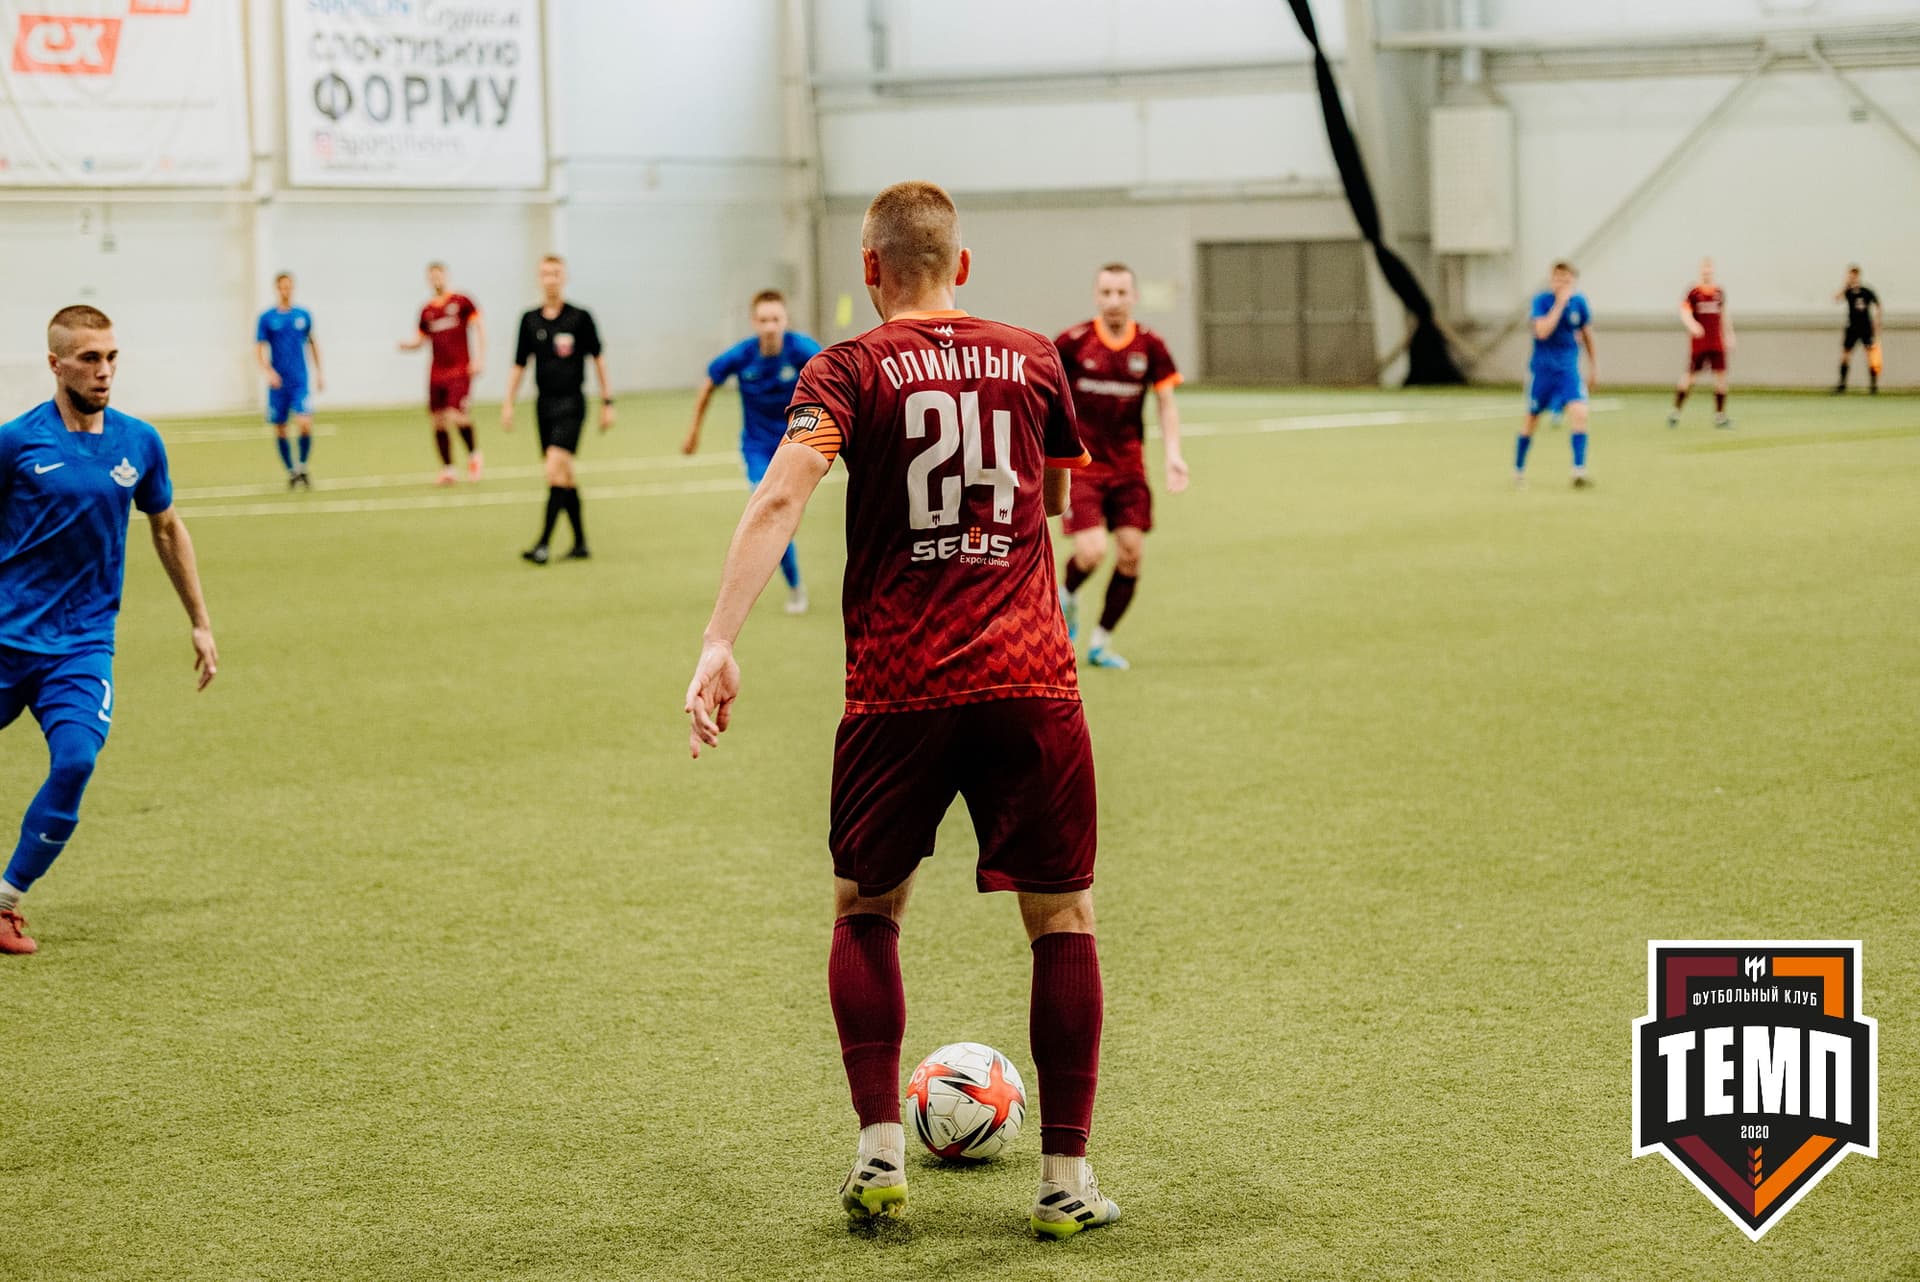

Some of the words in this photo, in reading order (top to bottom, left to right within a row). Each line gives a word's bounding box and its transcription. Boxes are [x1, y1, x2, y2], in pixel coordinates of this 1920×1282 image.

[313, 72, 516, 127] ФОРМУ
[880, 339, 1027, 390] ОЛИЙНЫК
[904, 390, 1020, 530] 24
[960, 555, 987, 565] Export
[988, 557, 1010, 568] Union
